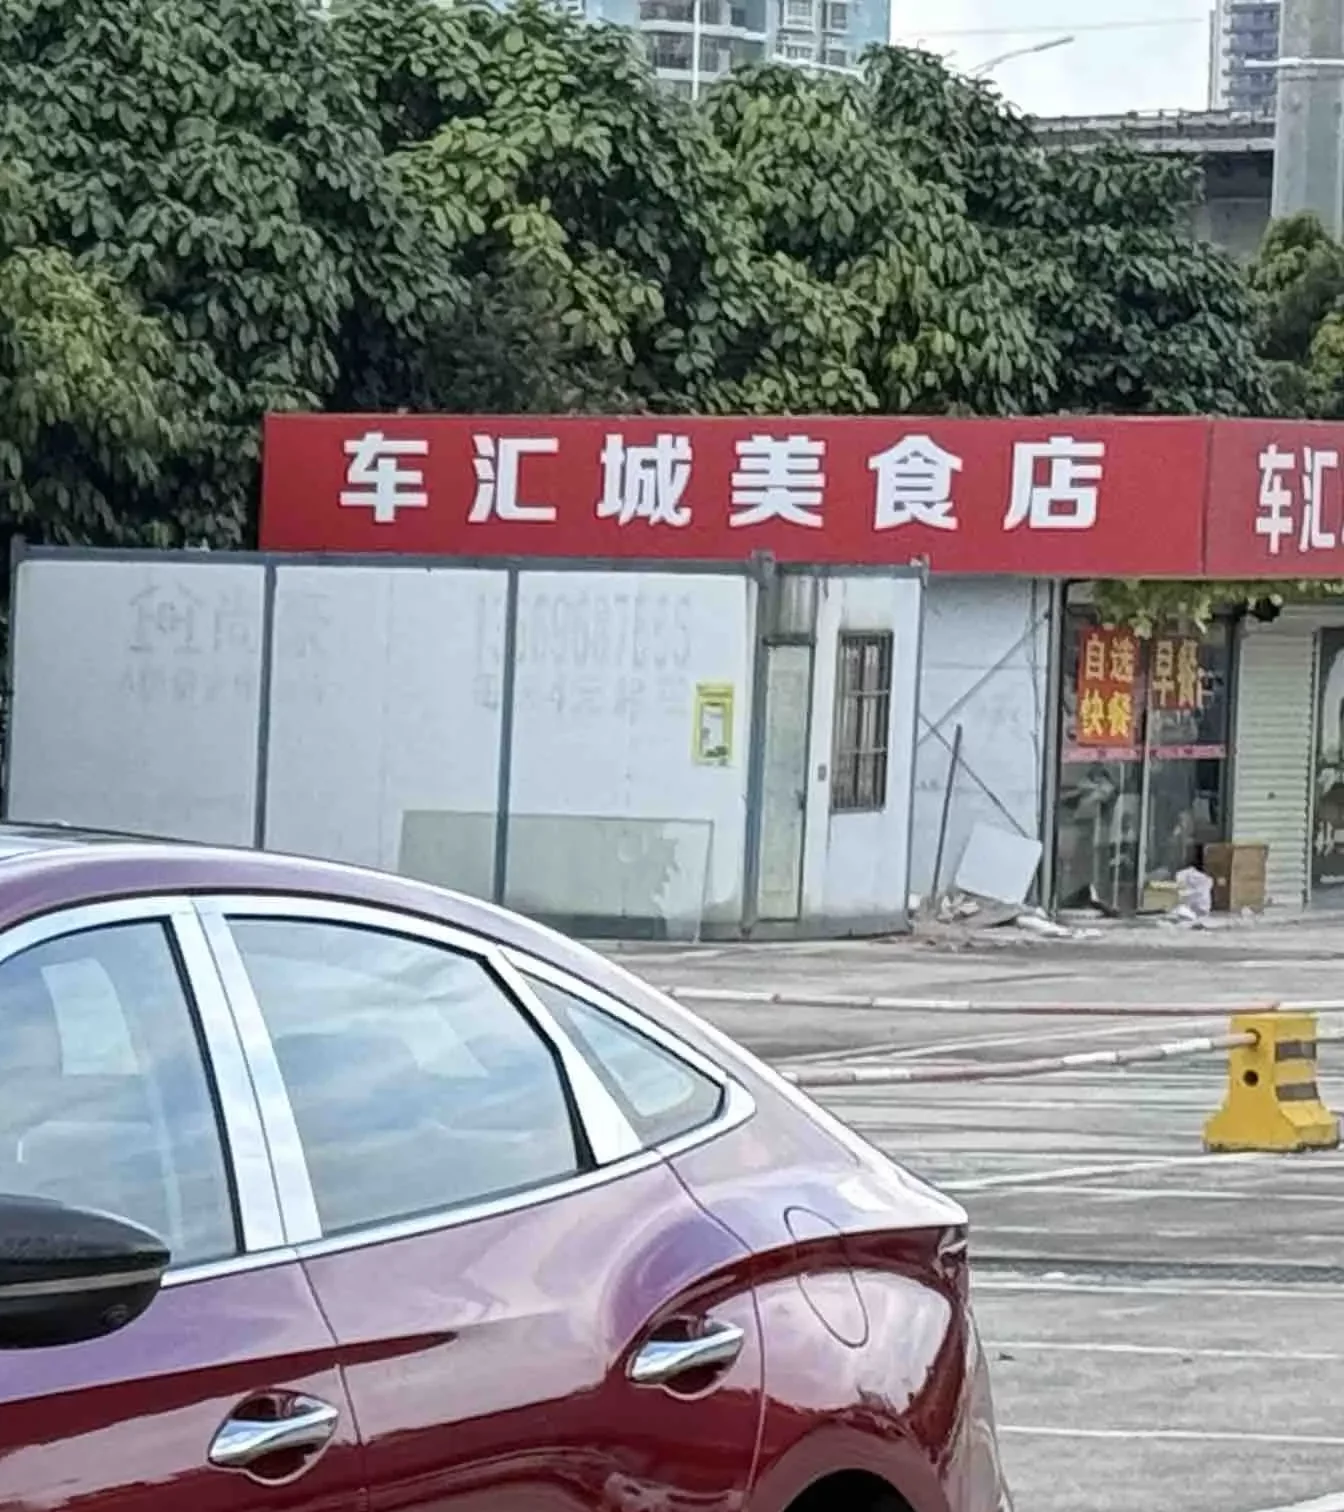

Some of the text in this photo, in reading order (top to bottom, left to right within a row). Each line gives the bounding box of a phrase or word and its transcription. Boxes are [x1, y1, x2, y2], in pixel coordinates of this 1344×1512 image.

[340, 431, 1106, 531] 车汇城美食店
[1255, 443, 1344, 555] 车汇
[1085, 633, 1135, 682] 自选
[1080, 689, 1134, 738] 快餐
